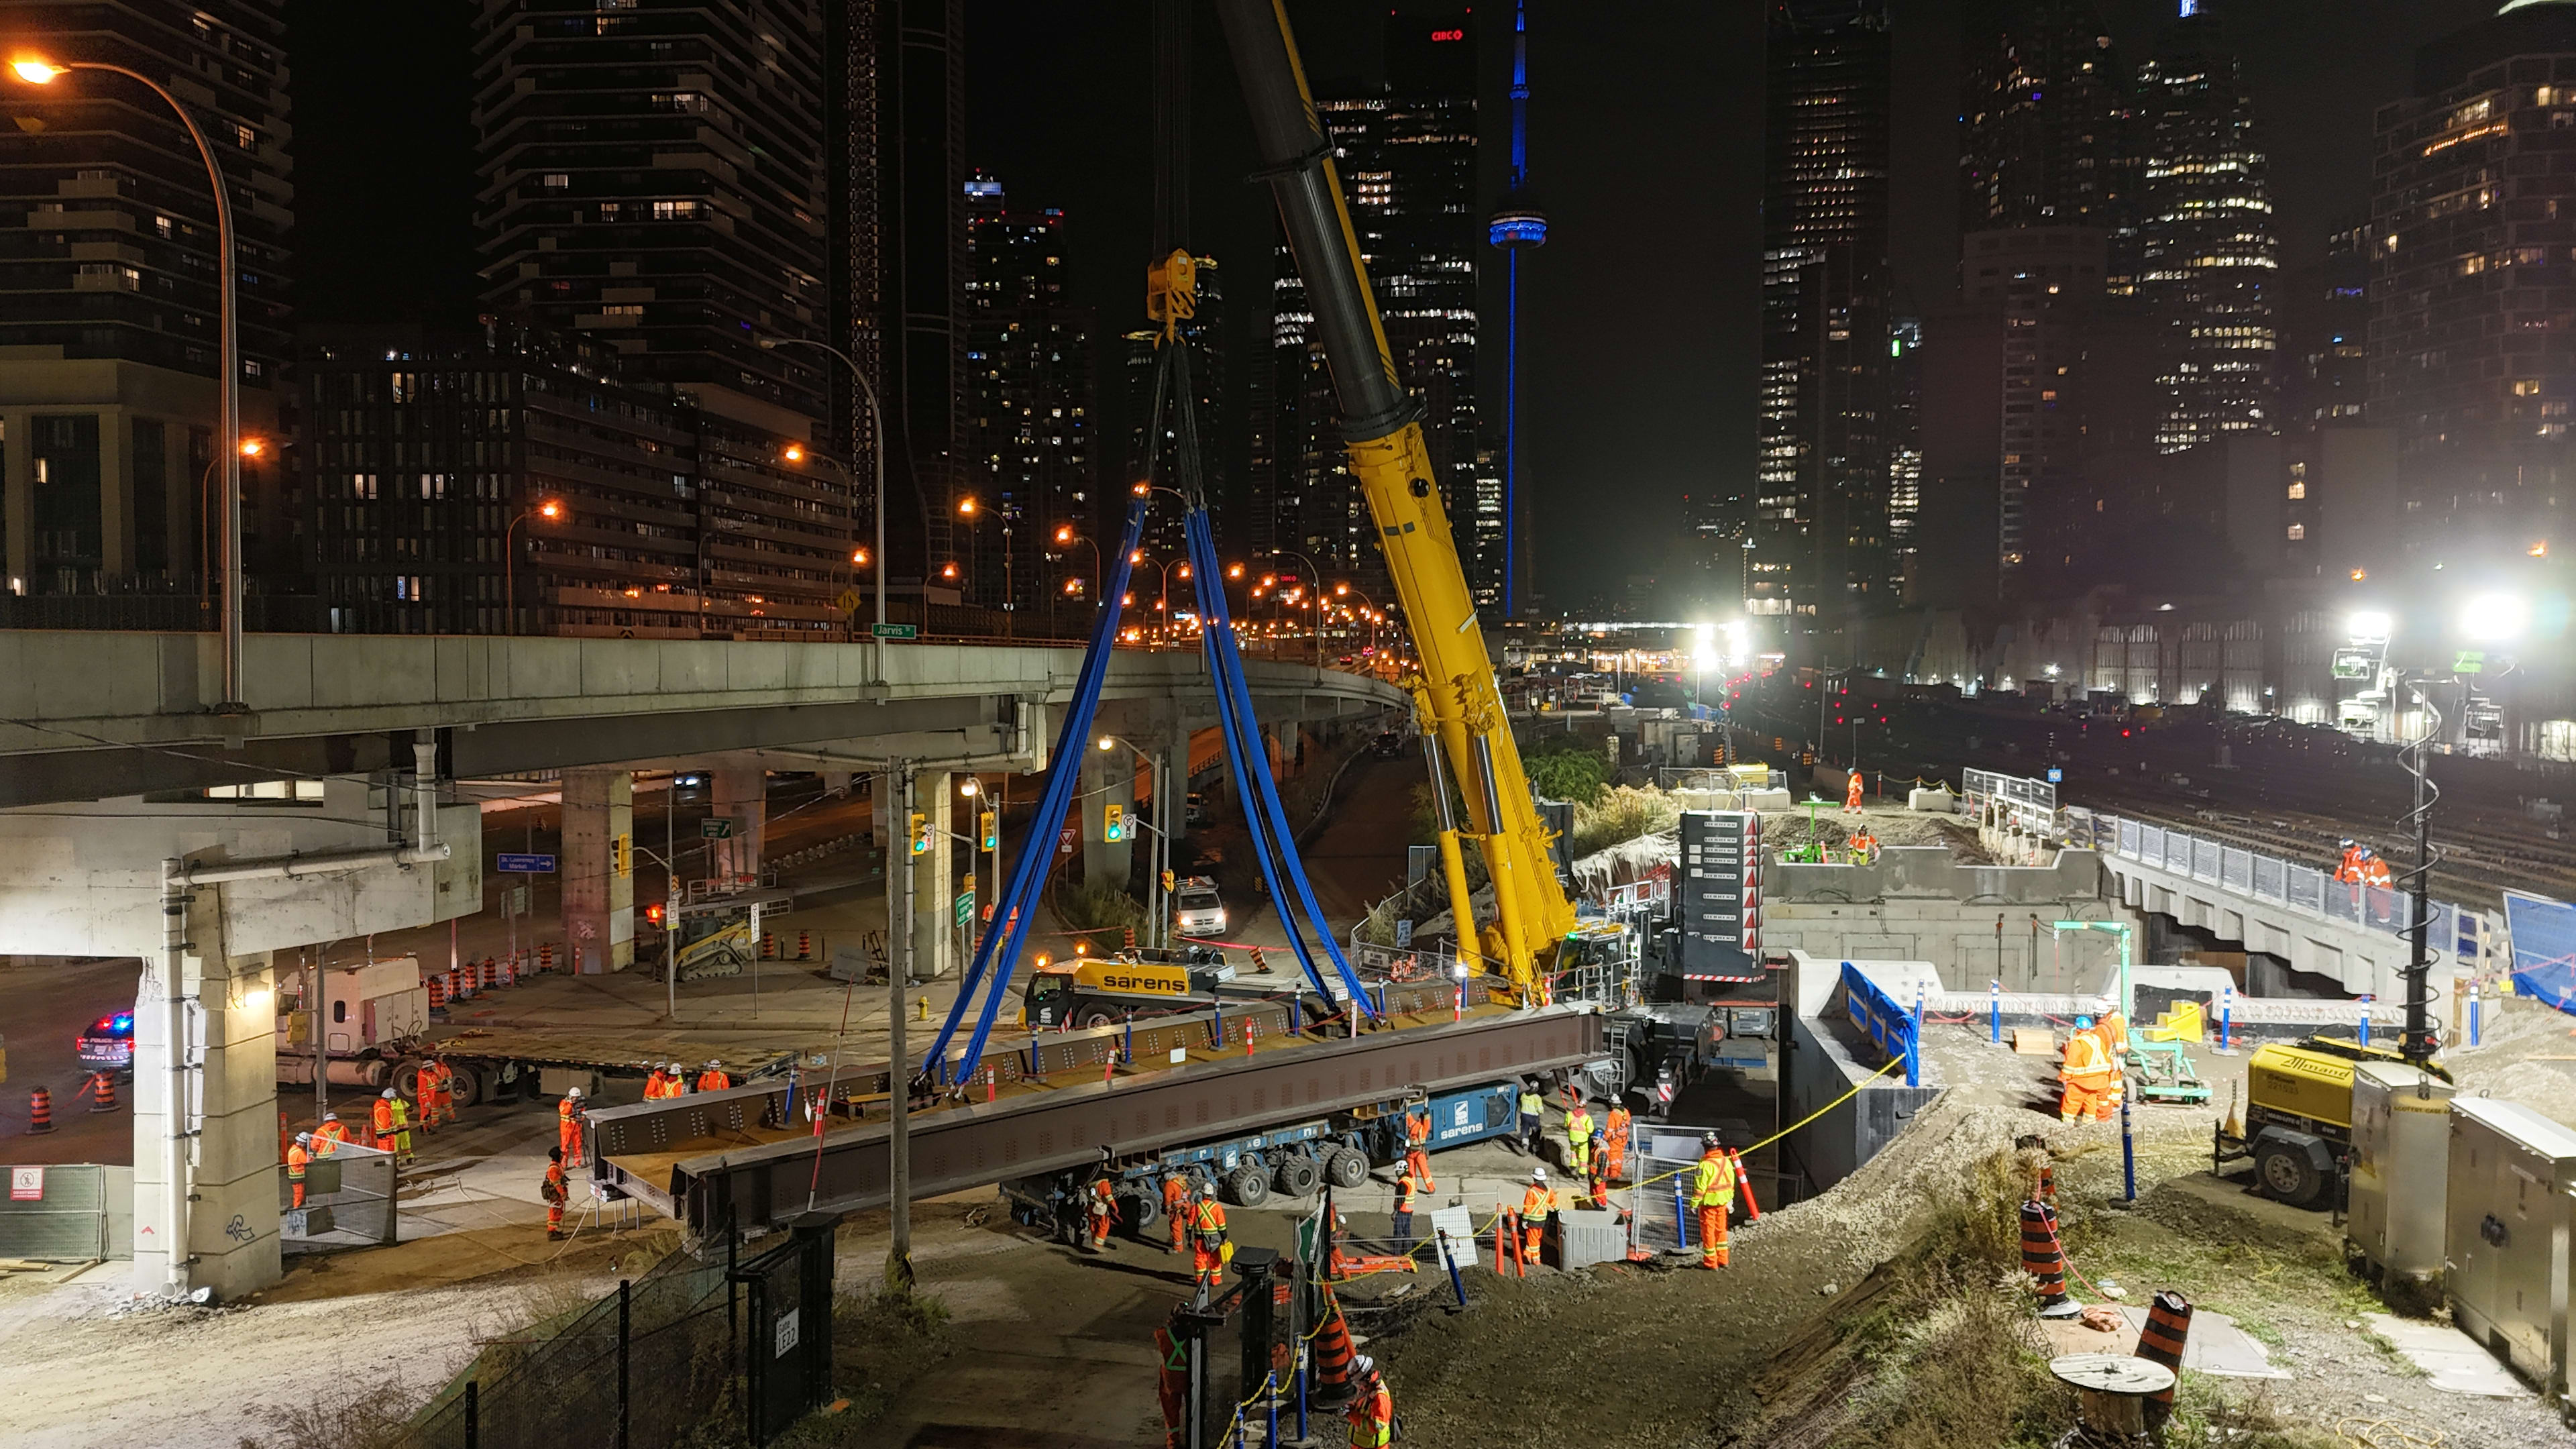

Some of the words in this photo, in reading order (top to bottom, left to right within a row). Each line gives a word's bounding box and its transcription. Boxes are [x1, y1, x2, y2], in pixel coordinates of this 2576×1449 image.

[1432, 31, 1453, 41] CIBC
[878, 625, 903, 635] Jarvis
[1104, 975, 1185, 991] sarens
[2281, 1057, 2350, 1080] Allmand
[1440, 1122, 1483, 1140] sarens
[779, 1328, 796, 1352] LE22
